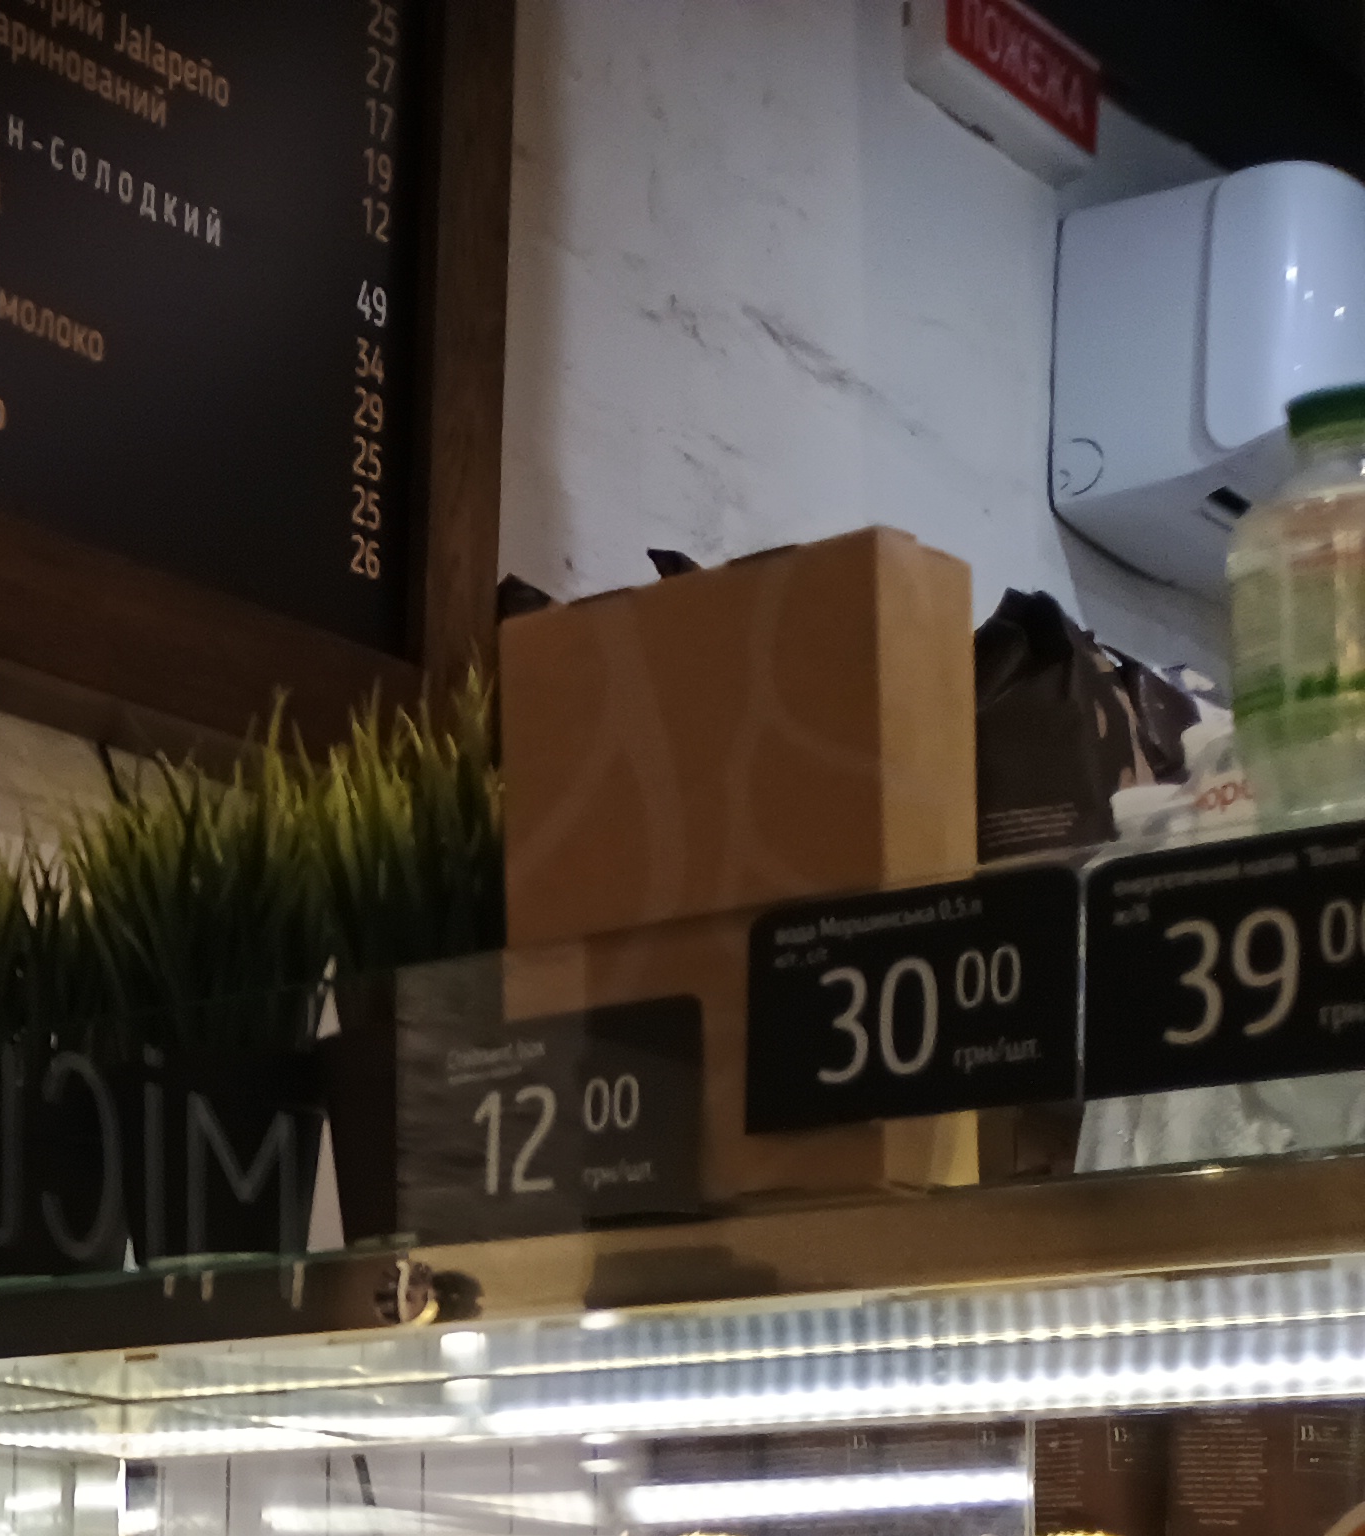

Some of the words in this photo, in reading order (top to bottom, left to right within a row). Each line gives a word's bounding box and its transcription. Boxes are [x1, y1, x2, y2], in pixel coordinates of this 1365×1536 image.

[368, 0, 398, 46] 25
[366, 47, 396, 93] 27
[365, 98, 395, 141] 17
[363, 147, 393, 193] 19
[362, 197, 390, 243] 12
[356, 279, 388, 328] 49
[355, 336, 385, 385] 34
[353, 385, 384, 433] 29
[352, 434, 383, 481] 25
[351, 484, 381, 531] 25
[350, 533, 380, 580] 26
[1162, 906, 1301, 1045] 39
[816, 954, 940, 1084] 30
[955, 942, 1022, 1010] 00
[474, 1083, 558, 1196] 12
[584, 1073, 640, 1133] 00
